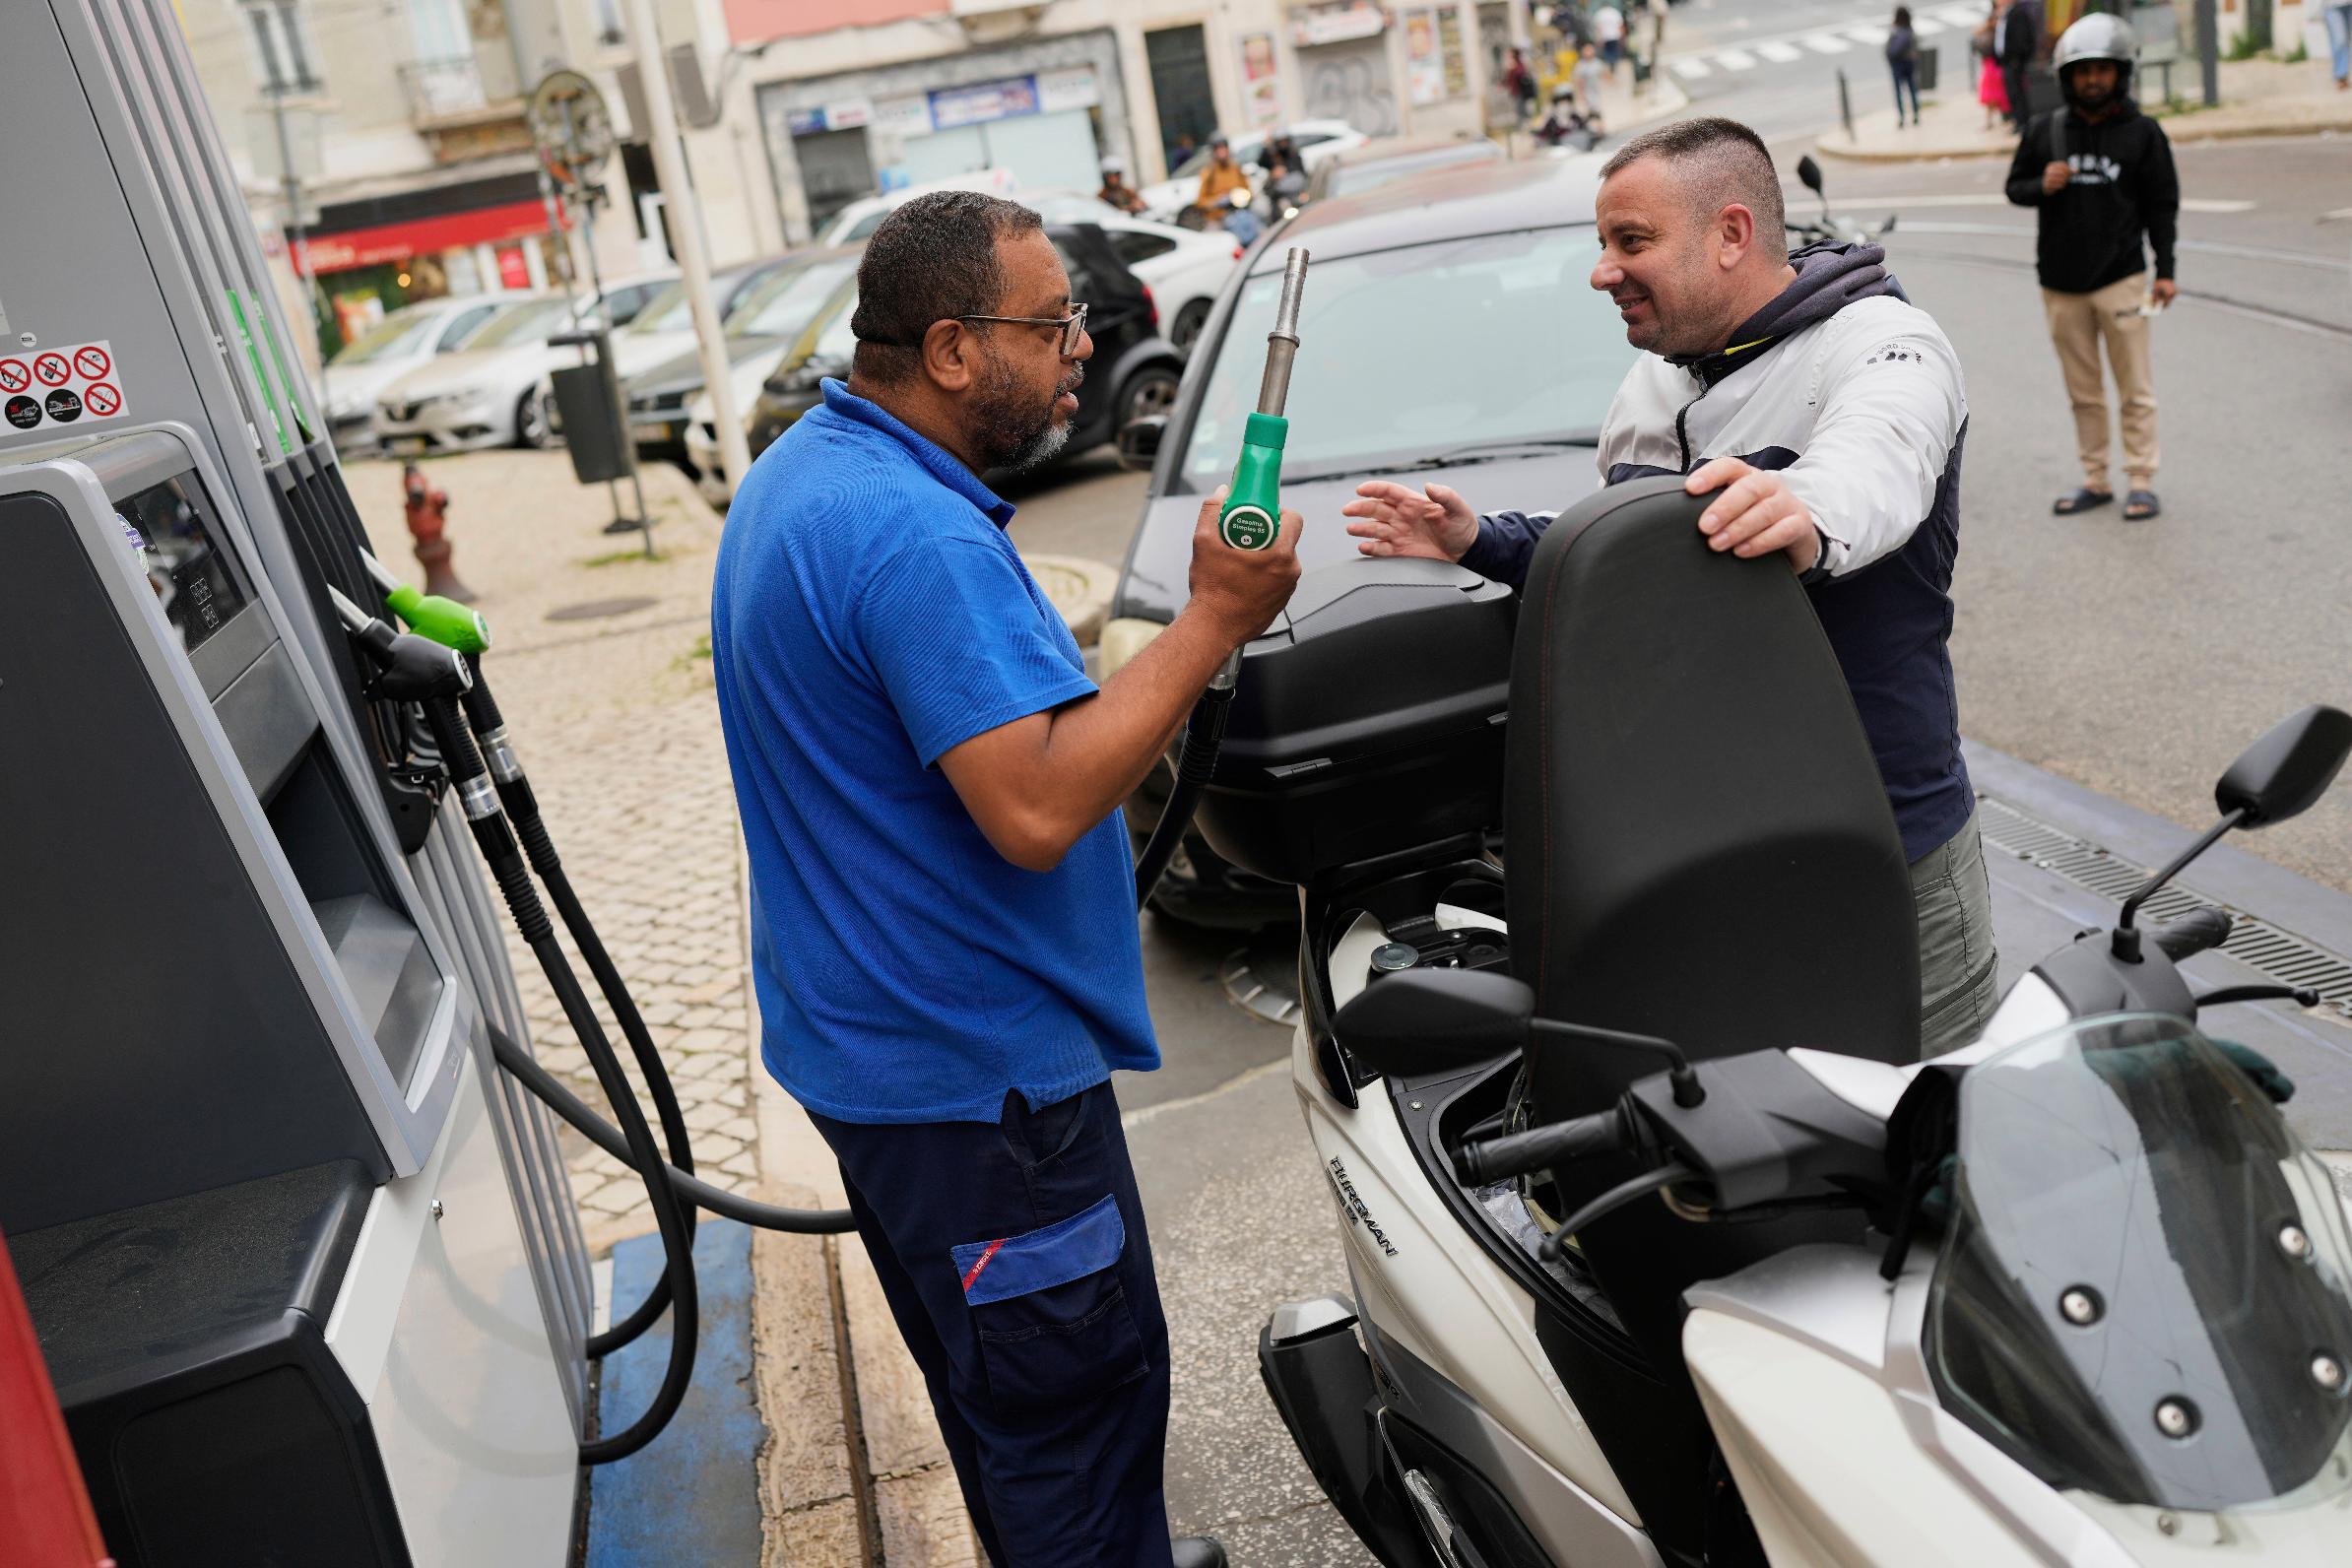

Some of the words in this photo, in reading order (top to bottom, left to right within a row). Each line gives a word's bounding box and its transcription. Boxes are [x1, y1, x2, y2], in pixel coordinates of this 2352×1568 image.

[1236, 517, 1264, 527] Gasolina
[1232, 523, 1257, 533] Simples
[1329, 1154, 1399, 1257] BURGMAN
